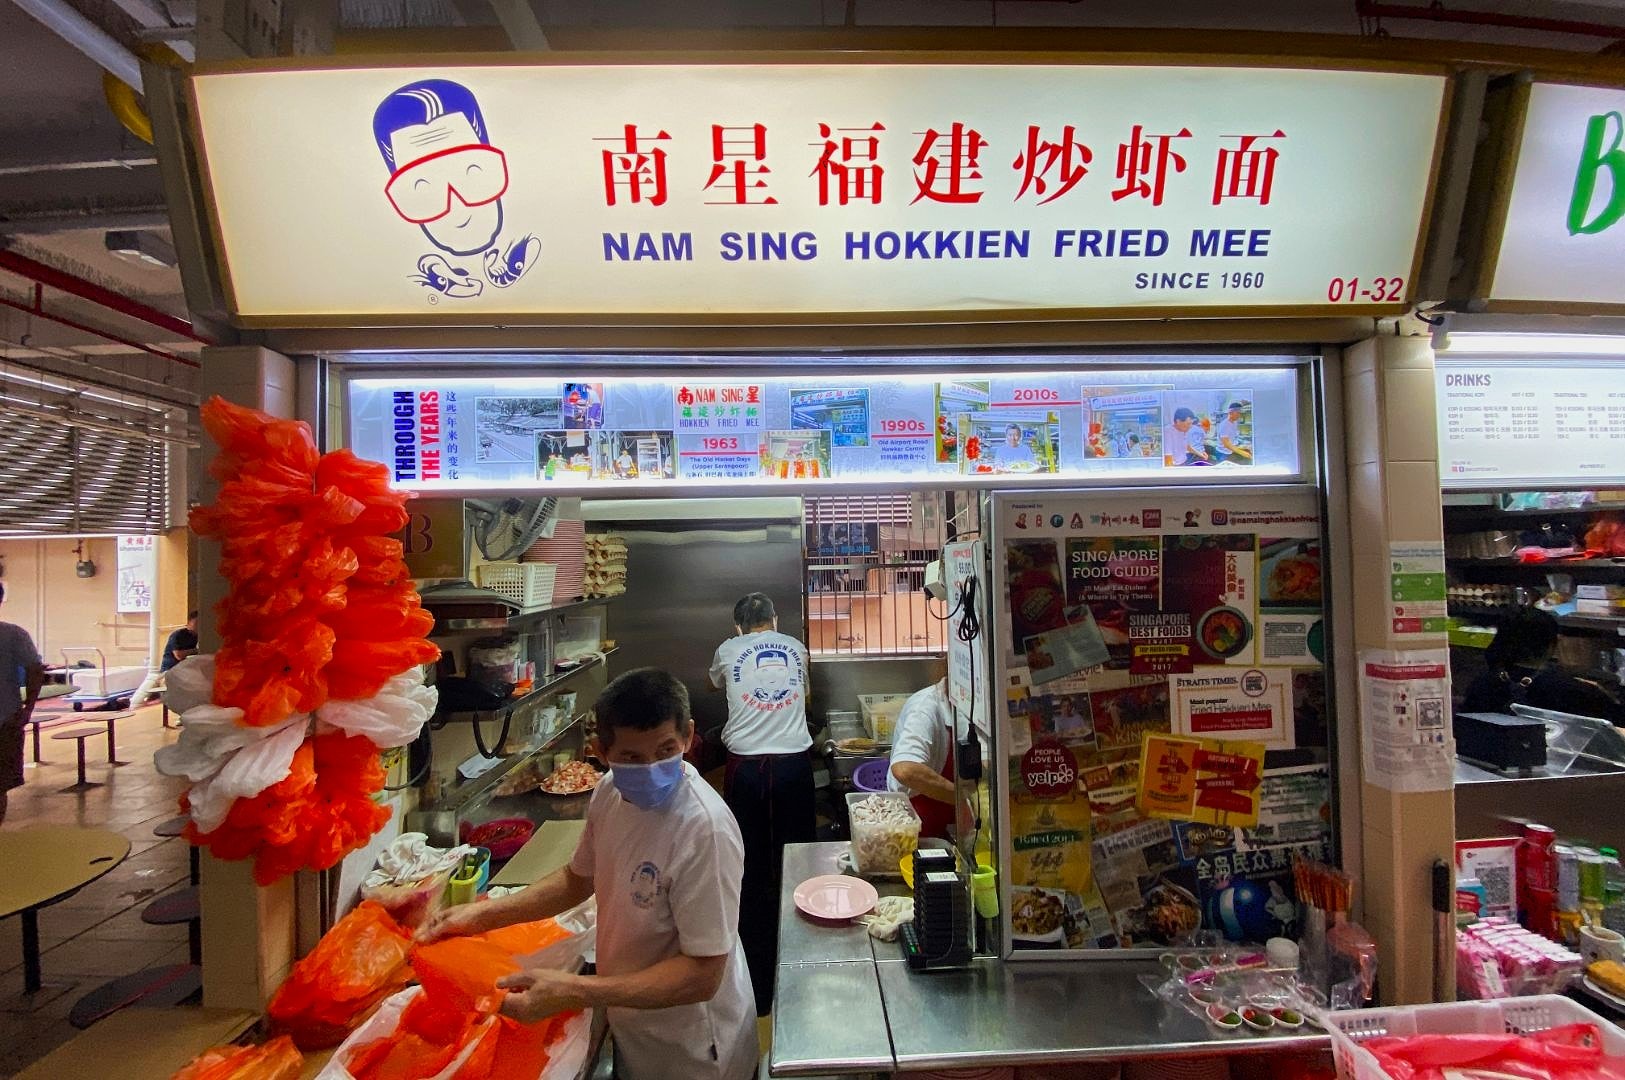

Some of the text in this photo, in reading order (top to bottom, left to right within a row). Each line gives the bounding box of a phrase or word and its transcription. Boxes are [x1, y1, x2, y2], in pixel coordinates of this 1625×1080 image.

[592, 121, 1288, 206] 南星福建炒虾面
[603, 229, 1272, 261] NAM SING HOKKIEN FRIED MEE
[1135, 271, 1265, 289] SINCE 1960
[1327, 277, 1404, 303] 01-32
[1446, 374, 1492, 387] DRINKS
[696, 388, 744, 402] NAM SING
[1013, 388, 1059, 401] 2010s
[680, 418, 710, 428] HOKKIEN
[718, 418, 738, 427] FRIED
[880, 420, 926, 432] 1990s
[393, 392, 416, 482] THROUGH
[419, 390, 441, 481] THE YEARS
[445, 391, 459, 480] 这些年来的变化
[703, 438, 738, 450] 1963
[1072, 549, 1159, 563] SINGAPORE
[1072, 566, 1159, 579] FOOD GUIDE
[1129, 613, 1190, 626] SINGAPORE
[1131, 626, 1189, 637] BEST FOODS
[733, 666, 741, 683] NAM
[737, 648, 753, 664] SING
[753, 643, 788, 652] HOKKIEN
[788, 648, 802, 667] FRIED
[1177, 678, 1210, 688] STRAITS
[1028, 770, 1059, 787] yelp
